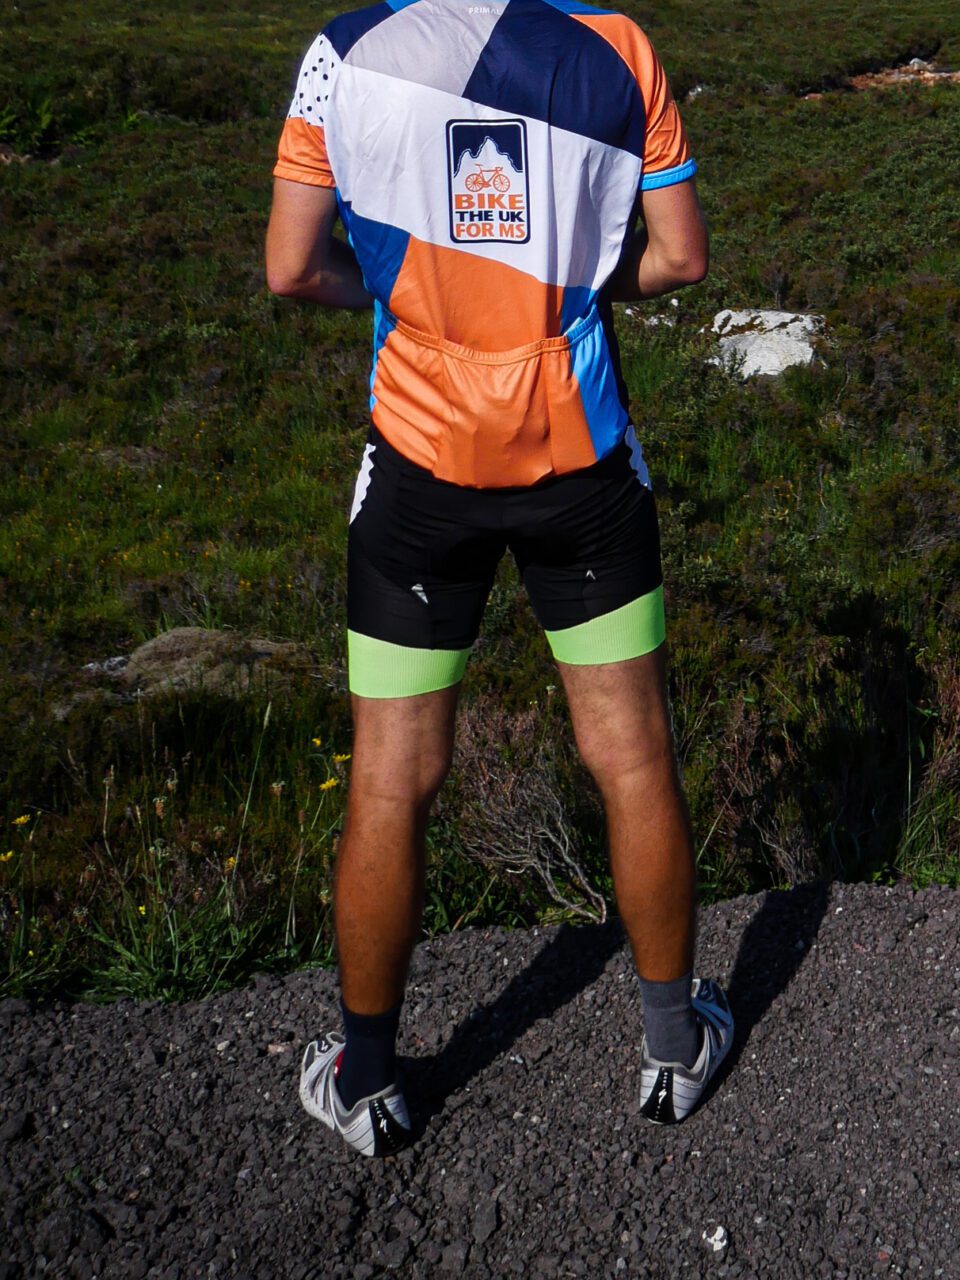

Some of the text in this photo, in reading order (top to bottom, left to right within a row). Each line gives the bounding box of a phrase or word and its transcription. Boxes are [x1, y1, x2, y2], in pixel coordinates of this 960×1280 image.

[469, 7, 501, 16] PRIMAL
[455, 193, 525, 210] BIKE
[455, 210, 525, 222] THE UK
[456, 223, 525, 238] FOR MS
